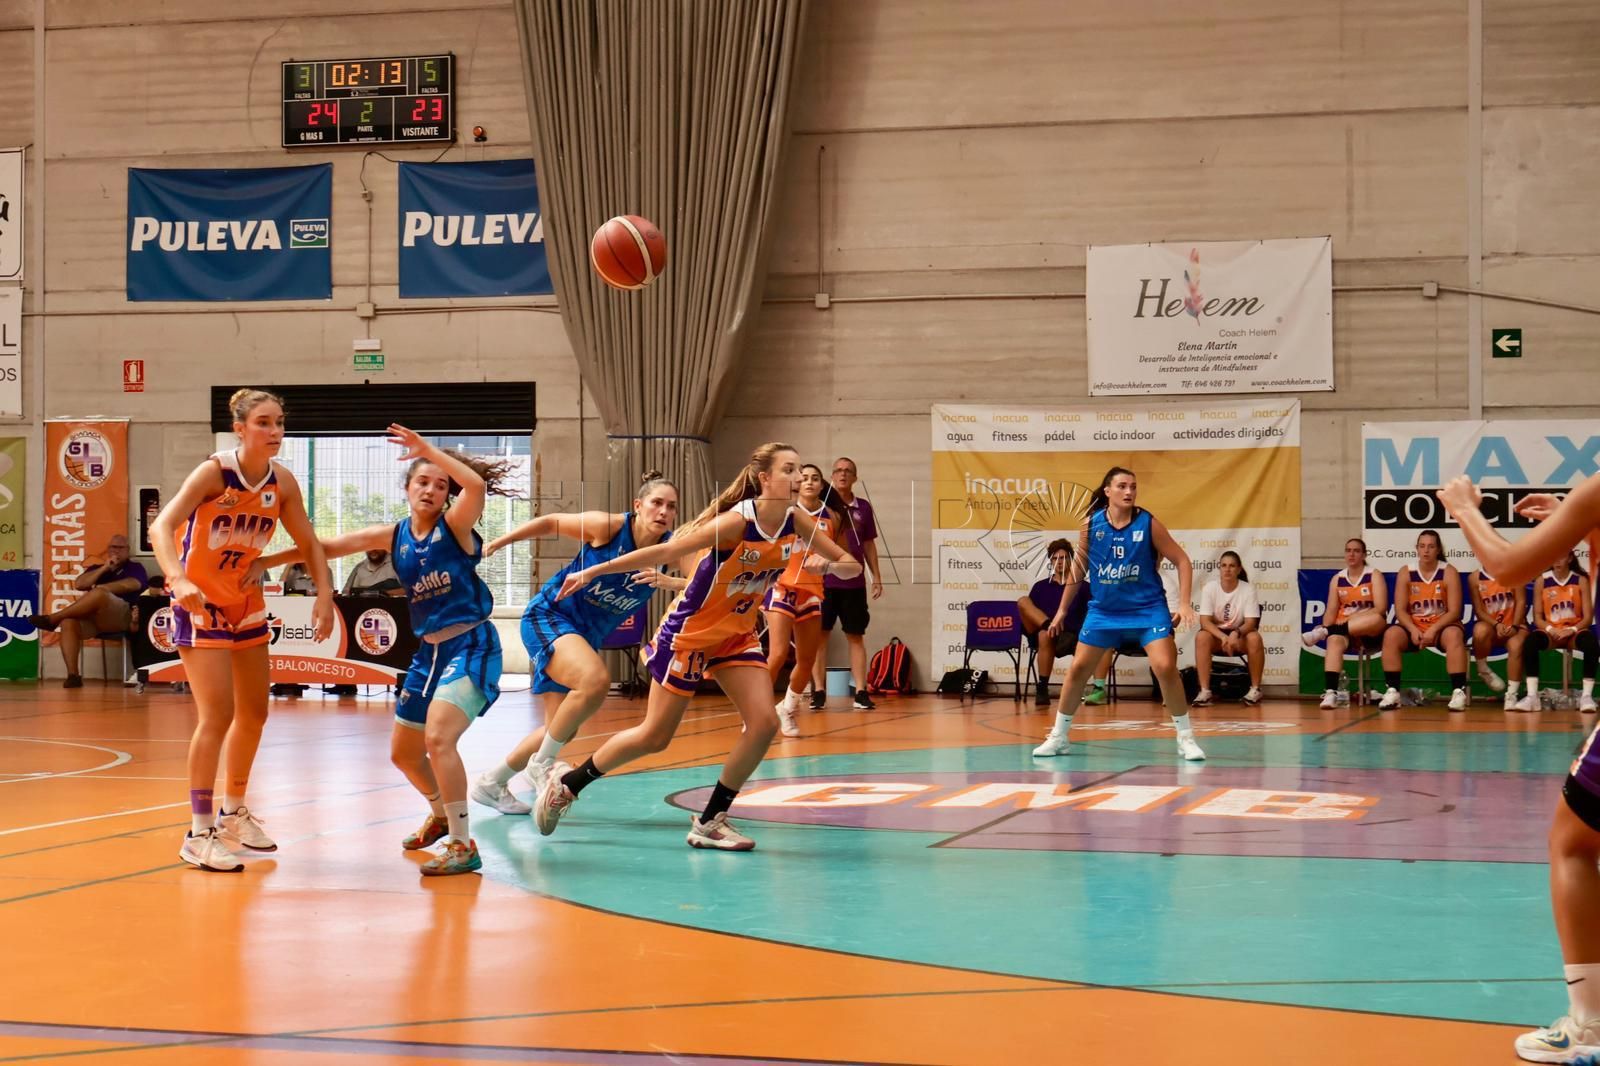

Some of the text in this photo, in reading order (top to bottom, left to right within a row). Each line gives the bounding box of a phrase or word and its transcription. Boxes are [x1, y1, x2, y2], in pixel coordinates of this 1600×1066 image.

[299, 66, 310, 88] 3
[331, 62, 402, 86] 02:13
[424, 60, 436, 82] 5
[308, 103, 337, 125] 24
[360, 101, 373, 123] 2
[412, 99, 442, 121] 23
[306, 131, 318, 141] MAS
[402, 126, 439, 137] VISITANTE
[130, 216, 282, 252] PULEVA
[293, 223, 325, 233] PULEVA
[1218, 328, 1277, 338] Coach Helem
[1177, 341, 1203, 351] Elena
[1138, 354, 1176, 363] Desarrollo
[1177, 354, 1187, 362] de
[1189, 353, 1231, 363] Inteligencia
[1233, 352, 1272, 361] emocional
[1158, 363, 1258, 373] instructora de Mindfulness
[992, 412, 1029, 423] inacua
[1044, 411, 1081, 423] inacua
[1096, 411, 1133, 422] inacua
[1147, 409, 1185, 421] inacua
[1200, 409, 1237, 420] inacua
[1252, 407, 1291, 419] inacua
[946, 426, 1284, 444] agua fitness pádel ciclo indoor actividades dirigidas
[965, 471, 1048, 496] inacua
[965, 497, 1012, 511] Antonio
[1369, 493, 1569, 525] COCH
[1251, 537, 1289, 548] inacua
[2, 551, 16, 563] 42
[218, 549, 246, 570] 77
[1111, 545, 1125, 560] 19
[1385, 549, 1419, 559] Grana
[1442, 548, 1475, 559] uliana
[46, 493, 86, 632] ECERÁS
[947, 558, 1029, 572] fitness pádel
[1252, 560, 1282, 572] agua
[1097, 563, 1140, 580] Melilla
[413, 569, 451, 596] elilla
[1262, 602, 1286, 612] door
[943, 623, 967, 632] inac
[976, 615, 1013, 629] GMB
[276, 659, 356, 679] BALONCESTO
[726, 782, 1382, 822] GMB
